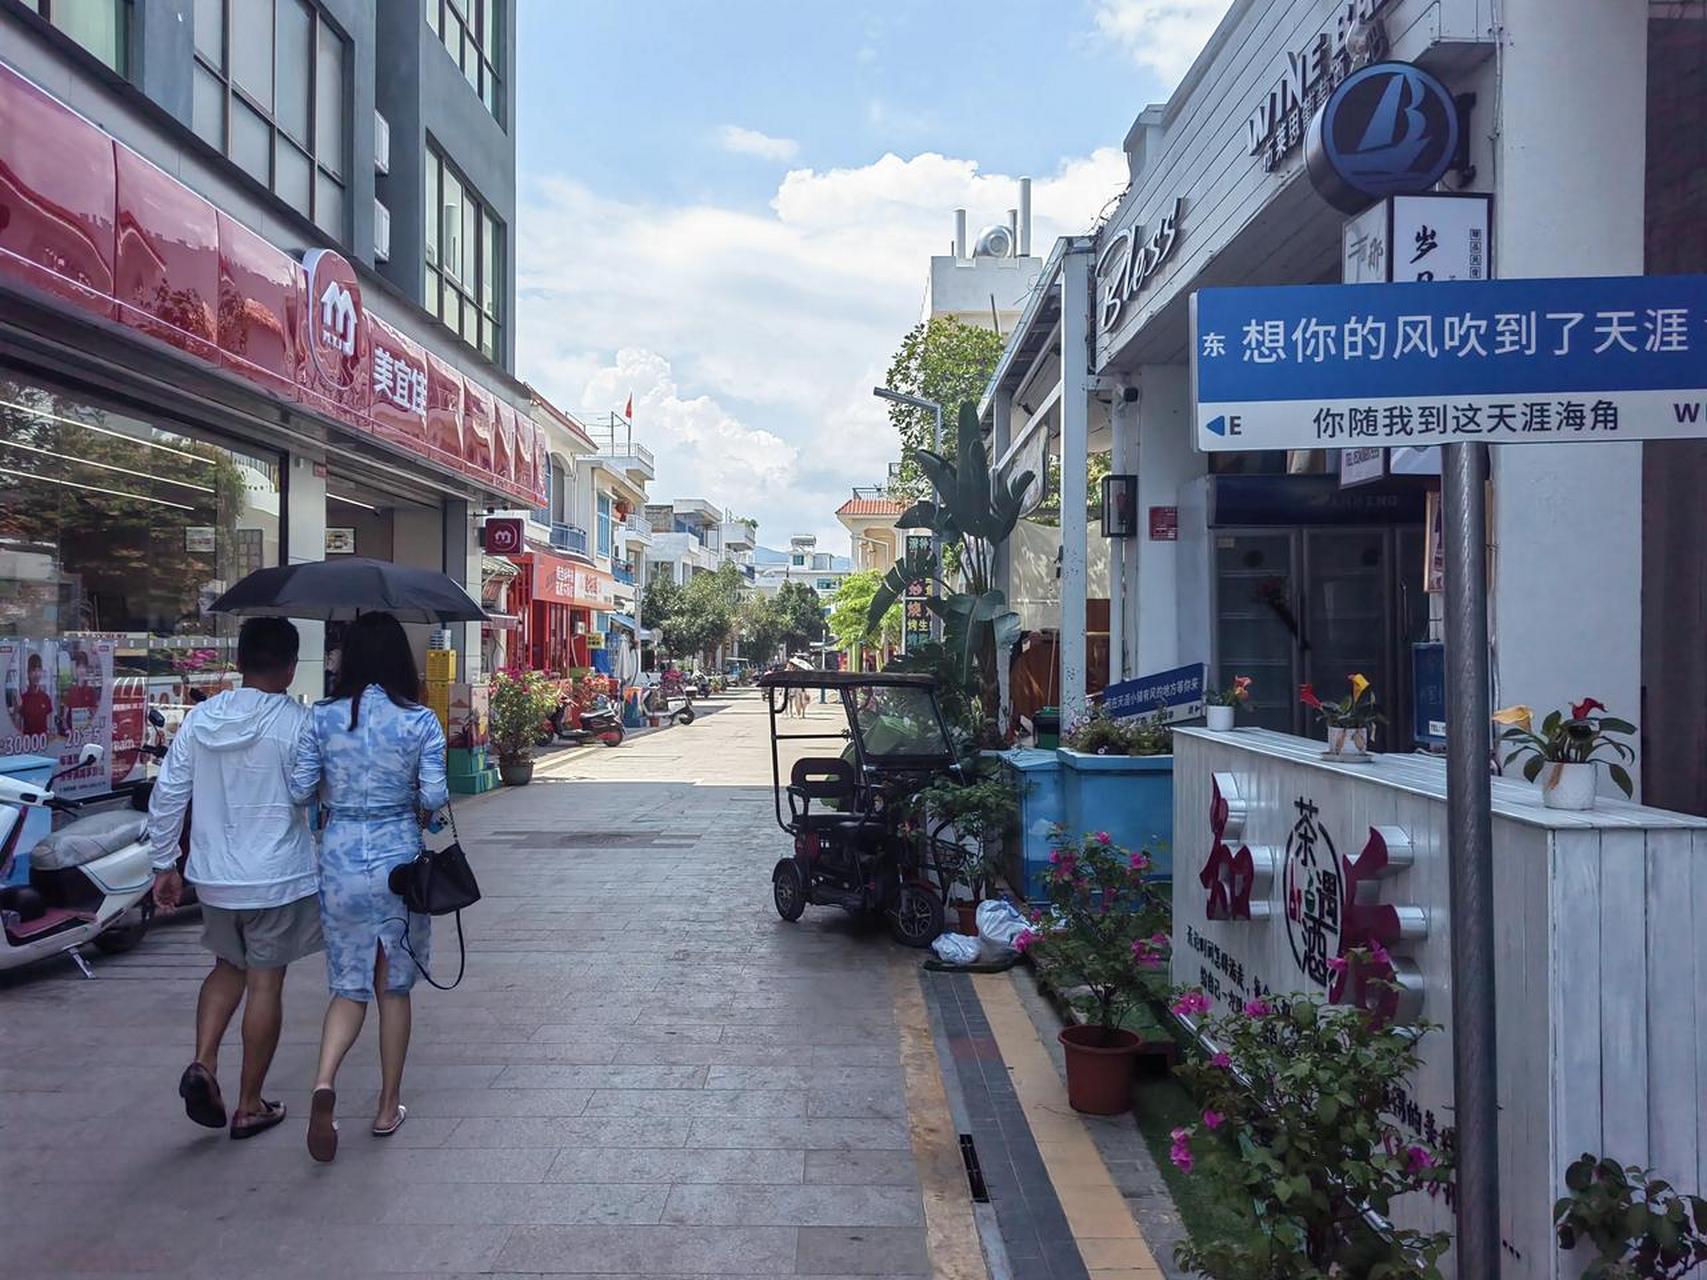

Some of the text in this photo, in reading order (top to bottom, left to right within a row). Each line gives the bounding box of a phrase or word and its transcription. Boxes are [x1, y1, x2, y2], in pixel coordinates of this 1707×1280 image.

[1248, 33, 1332, 156] WINE
[1096, 197, 1184, 332] Bless
[1202, 331, 1226, 357] 东
[1242, 308, 1690, 364] 想你的风吹到了天涯
[373, 346, 427, 417] 美宜佳
[1229, 416, 1242, 435] E
[1312, 400, 1619, 439] 你随我到这天涯海角
[1673, 404, 1700, 424] W
